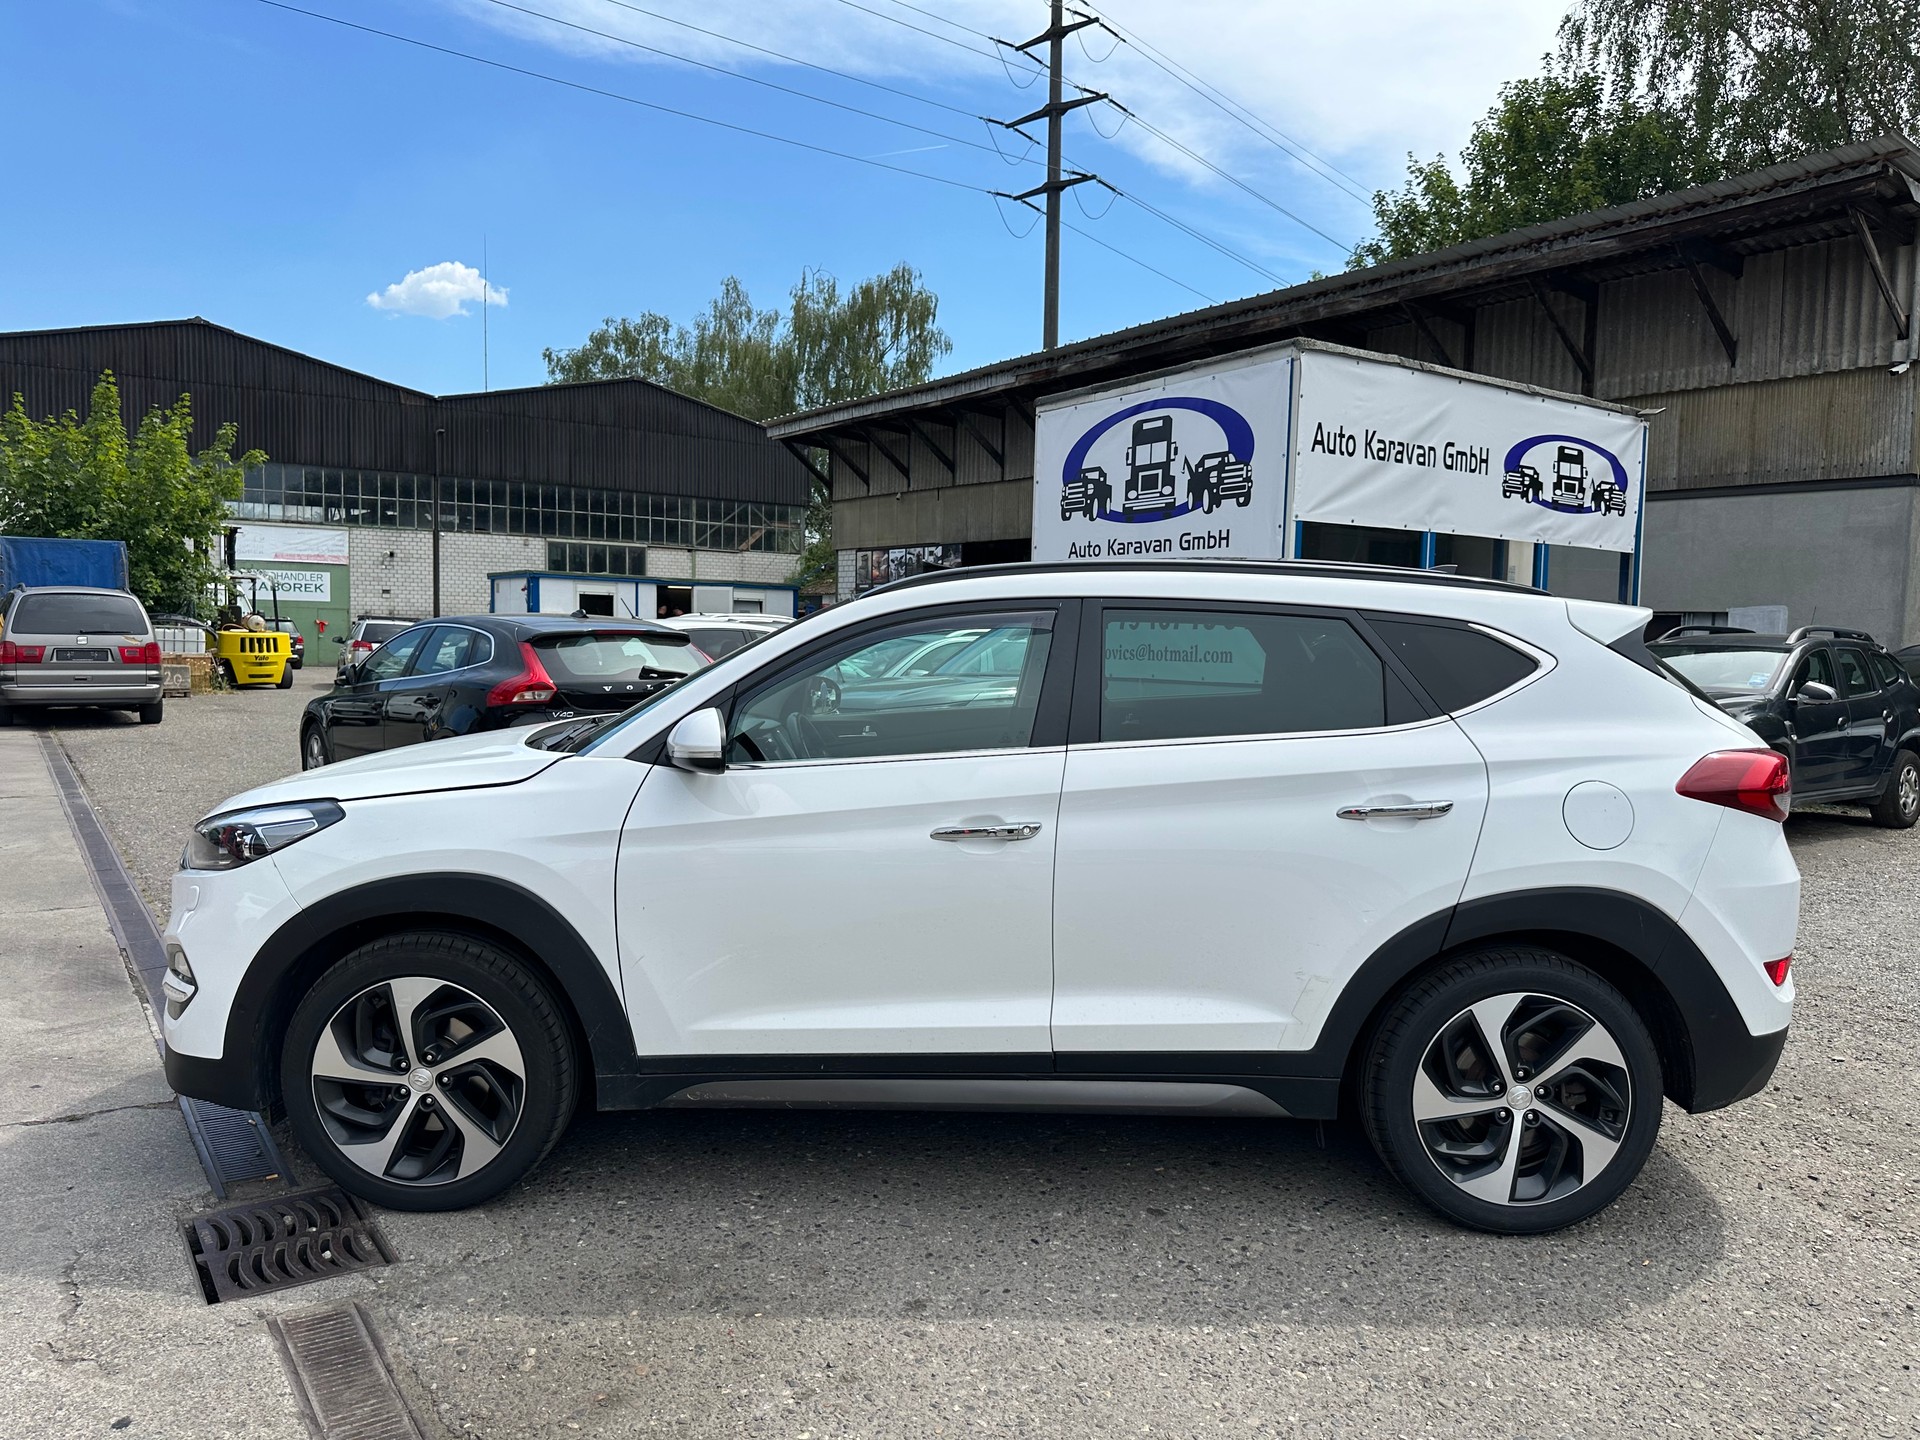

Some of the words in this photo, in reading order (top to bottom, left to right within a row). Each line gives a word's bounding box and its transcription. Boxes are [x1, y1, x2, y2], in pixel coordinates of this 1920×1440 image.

[1310, 421, 1357, 457] Auto
[1364, 428, 1437, 468] Karavan
[1443, 441, 1490, 476] GmbH
[1068, 541, 1102, 559] Auto
[1107, 537, 1172, 556] Karavan
[1179, 529, 1231, 551] GmbH
